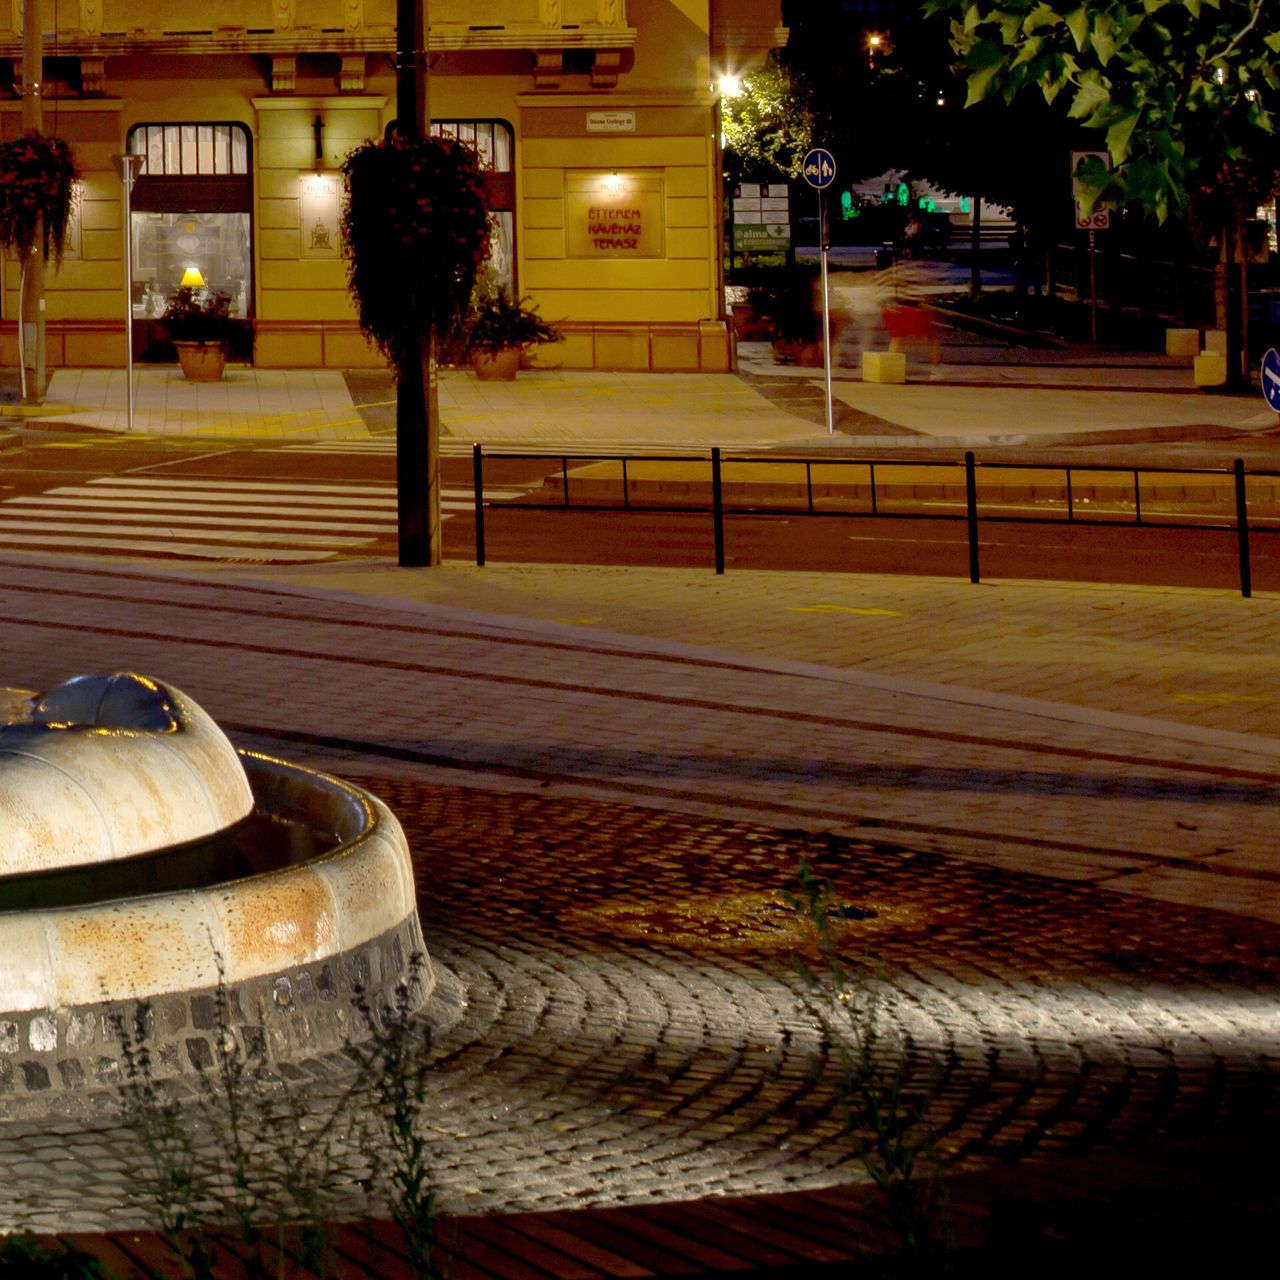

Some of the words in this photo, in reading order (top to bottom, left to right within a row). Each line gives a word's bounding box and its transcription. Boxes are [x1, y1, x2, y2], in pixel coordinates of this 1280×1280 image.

[588, 208, 640, 219] ÉTTEREM
[588, 223, 641, 234] KÁVÉHÁZ
[593, 238, 638, 249] TERASZ
